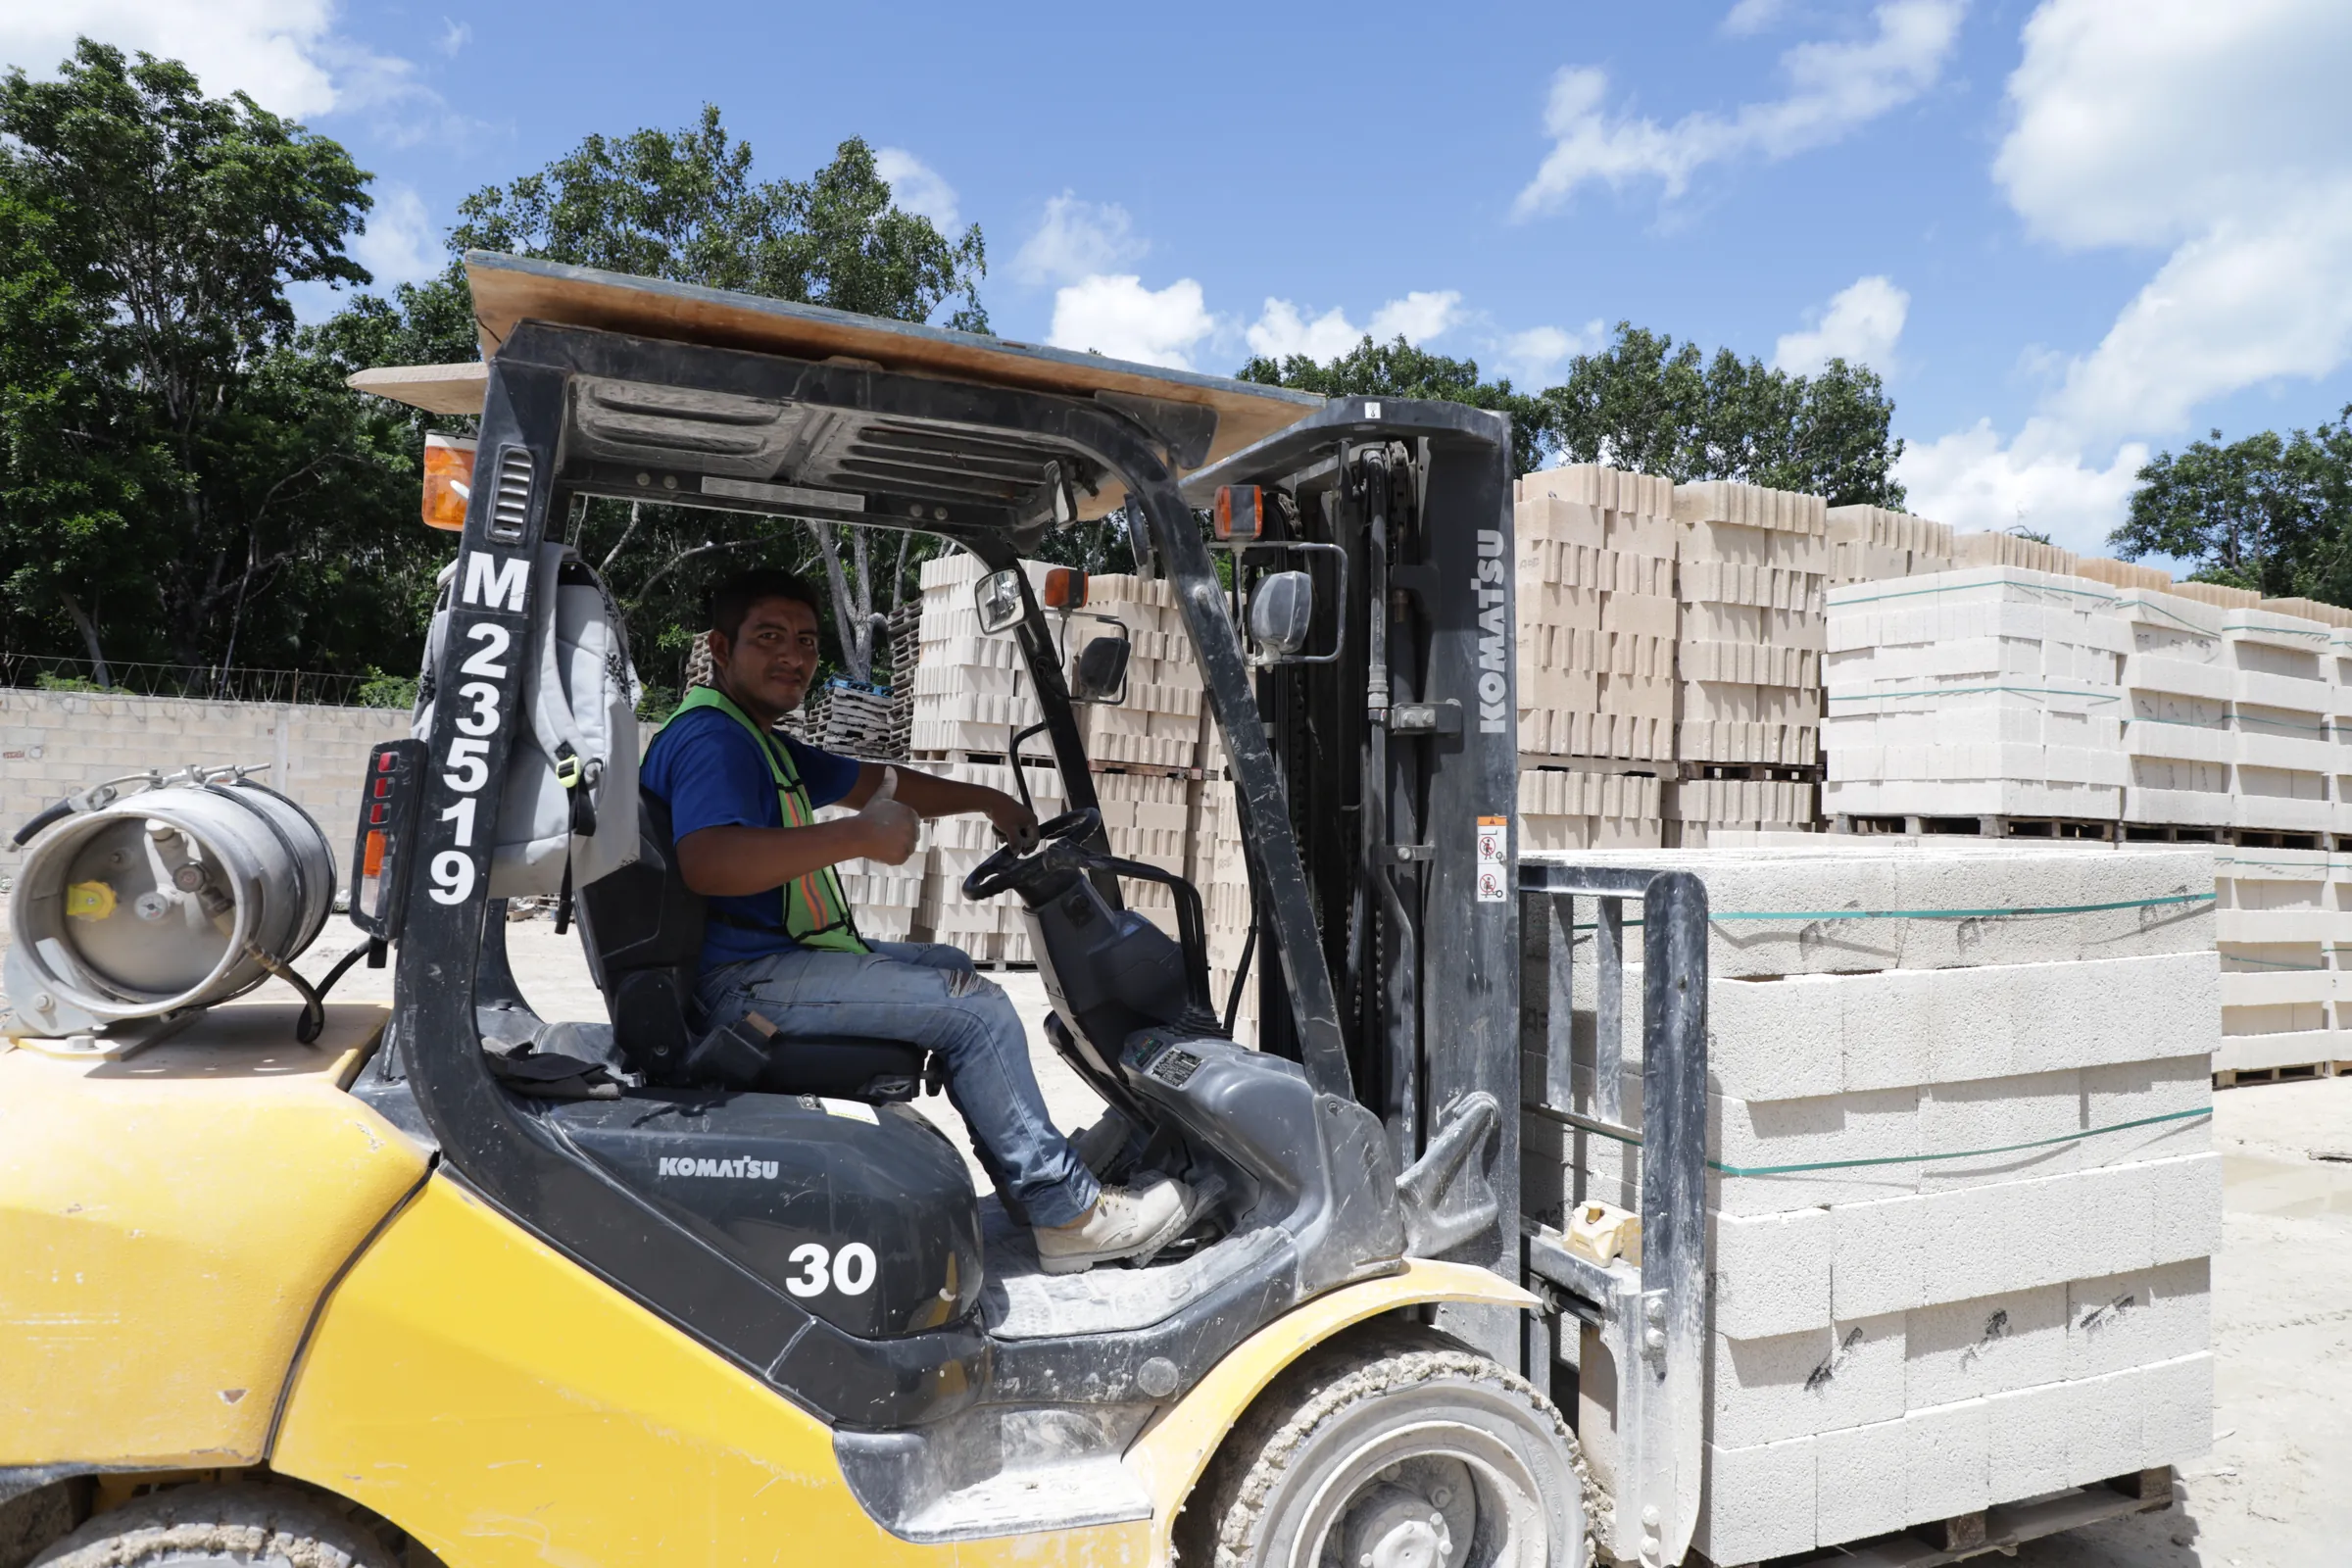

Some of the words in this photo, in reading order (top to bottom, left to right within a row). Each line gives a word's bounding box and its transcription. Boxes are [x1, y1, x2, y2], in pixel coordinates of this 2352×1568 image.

[1470, 529, 1507, 734] KOMATSU
[428, 551, 530, 906] M23519
[658, 1154, 780, 1180] KOMATSU
[785, 1242, 877, 1298] 30
